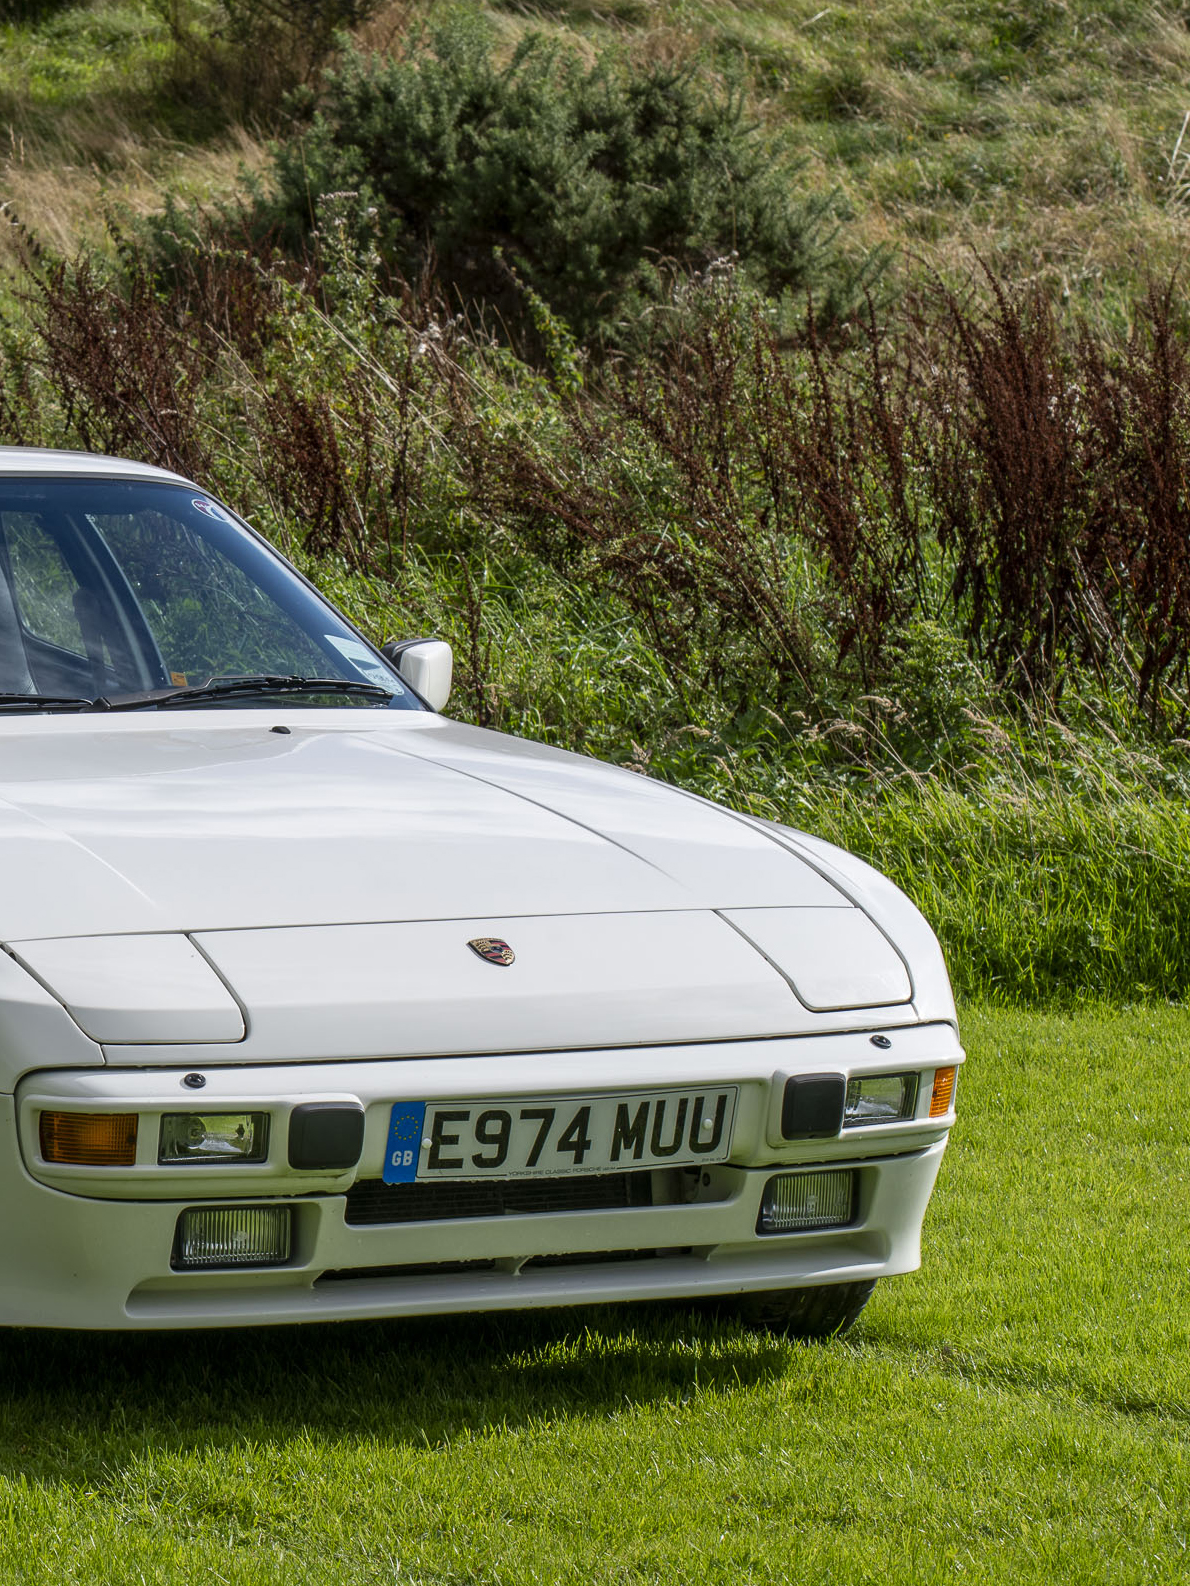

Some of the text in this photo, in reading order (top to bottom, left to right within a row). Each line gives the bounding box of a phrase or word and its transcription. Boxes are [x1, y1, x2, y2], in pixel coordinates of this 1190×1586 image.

[427, 1094, 728, 1169] E974 MUU
[391, 1150, 414, 1167] GB
[572, 1165, 602, 1174] PORSCHE
